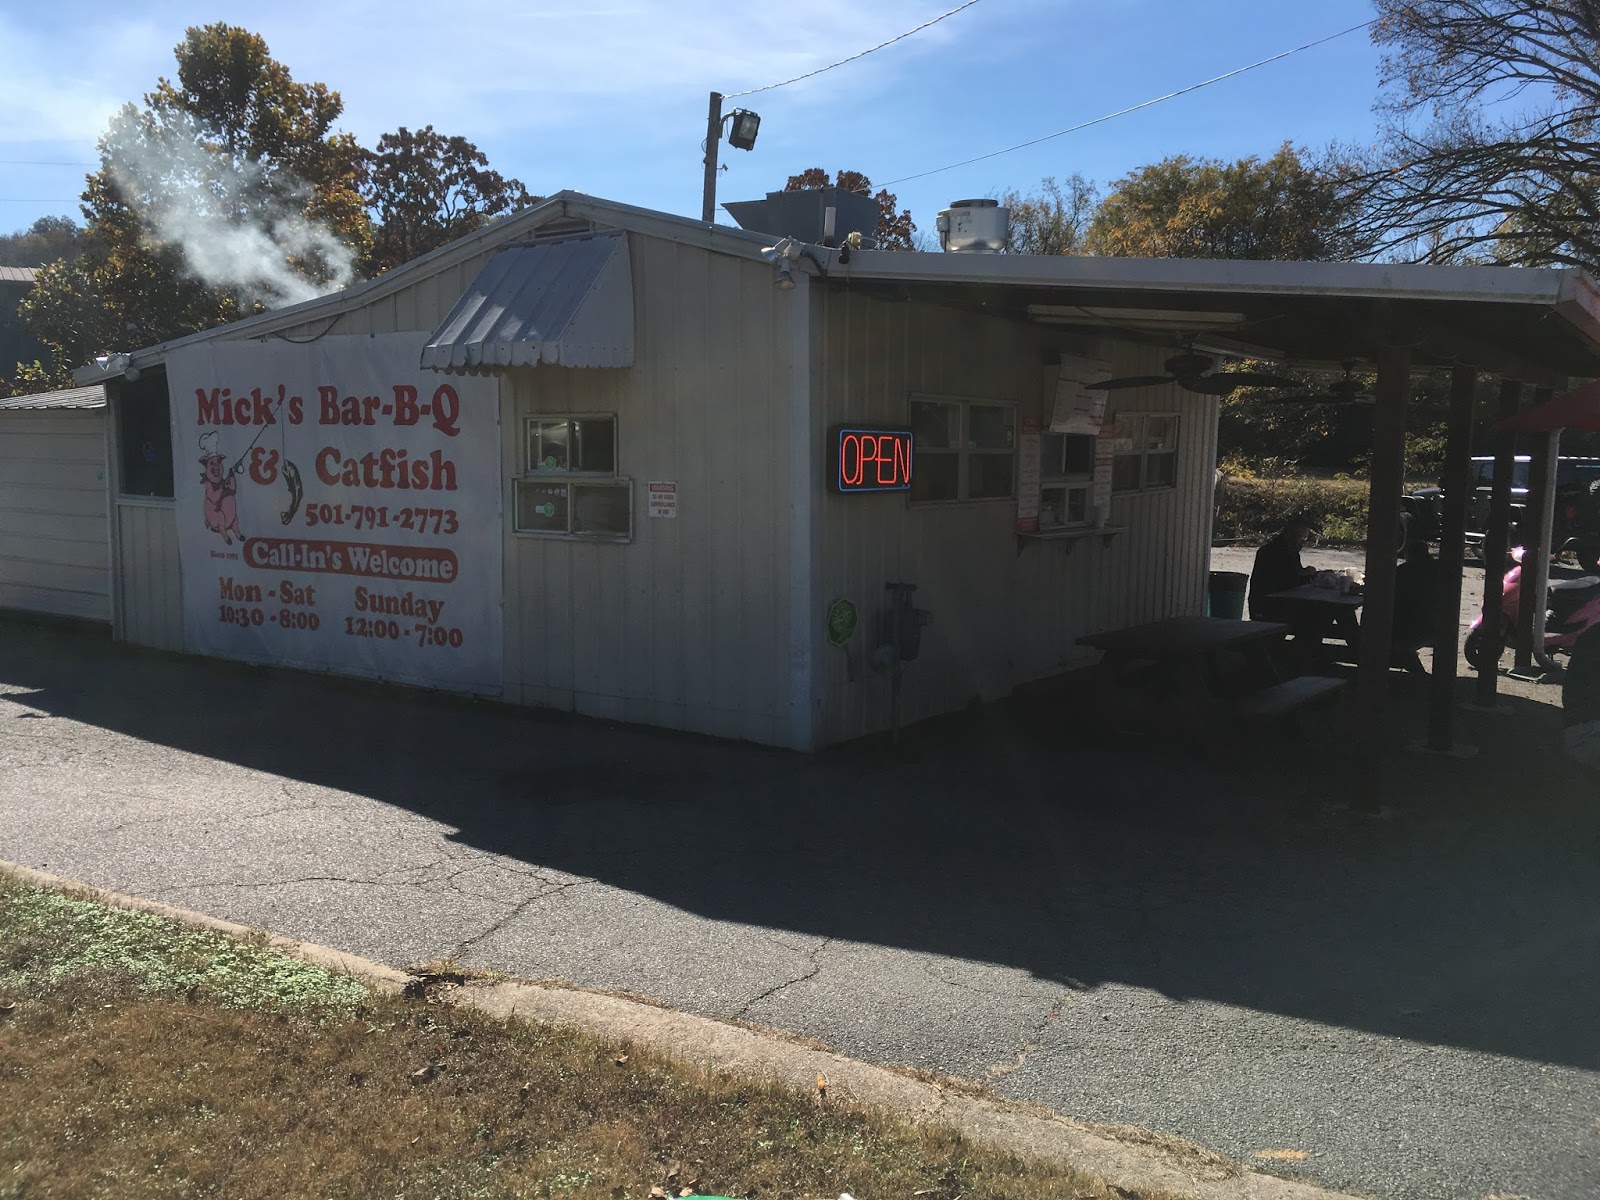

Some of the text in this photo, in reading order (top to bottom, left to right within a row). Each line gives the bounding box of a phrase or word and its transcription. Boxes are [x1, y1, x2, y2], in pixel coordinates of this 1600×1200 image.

[195, 384, 461, 437] Mick's Bar-B-Q
[249, 446, 458, 491] & Catfish
[841, 435, 911, 485] OPEN
[651, 484, 674, 492] WARNING
[305, 503, 459, 535] 501-791-2773
[252, 541, 454, 579] Call-In's Welcome
[218, 576, 262, 602] Mon
[279, 580, 316, 607] Sat
[354, 586, 445, 625] Sunday
[218, 605, 264, 628] 10:30
[279, 608, 320, 631] 8:00
[344, 616, 399, 640] 12:00
[414, 624, 463, 648] 7:00
